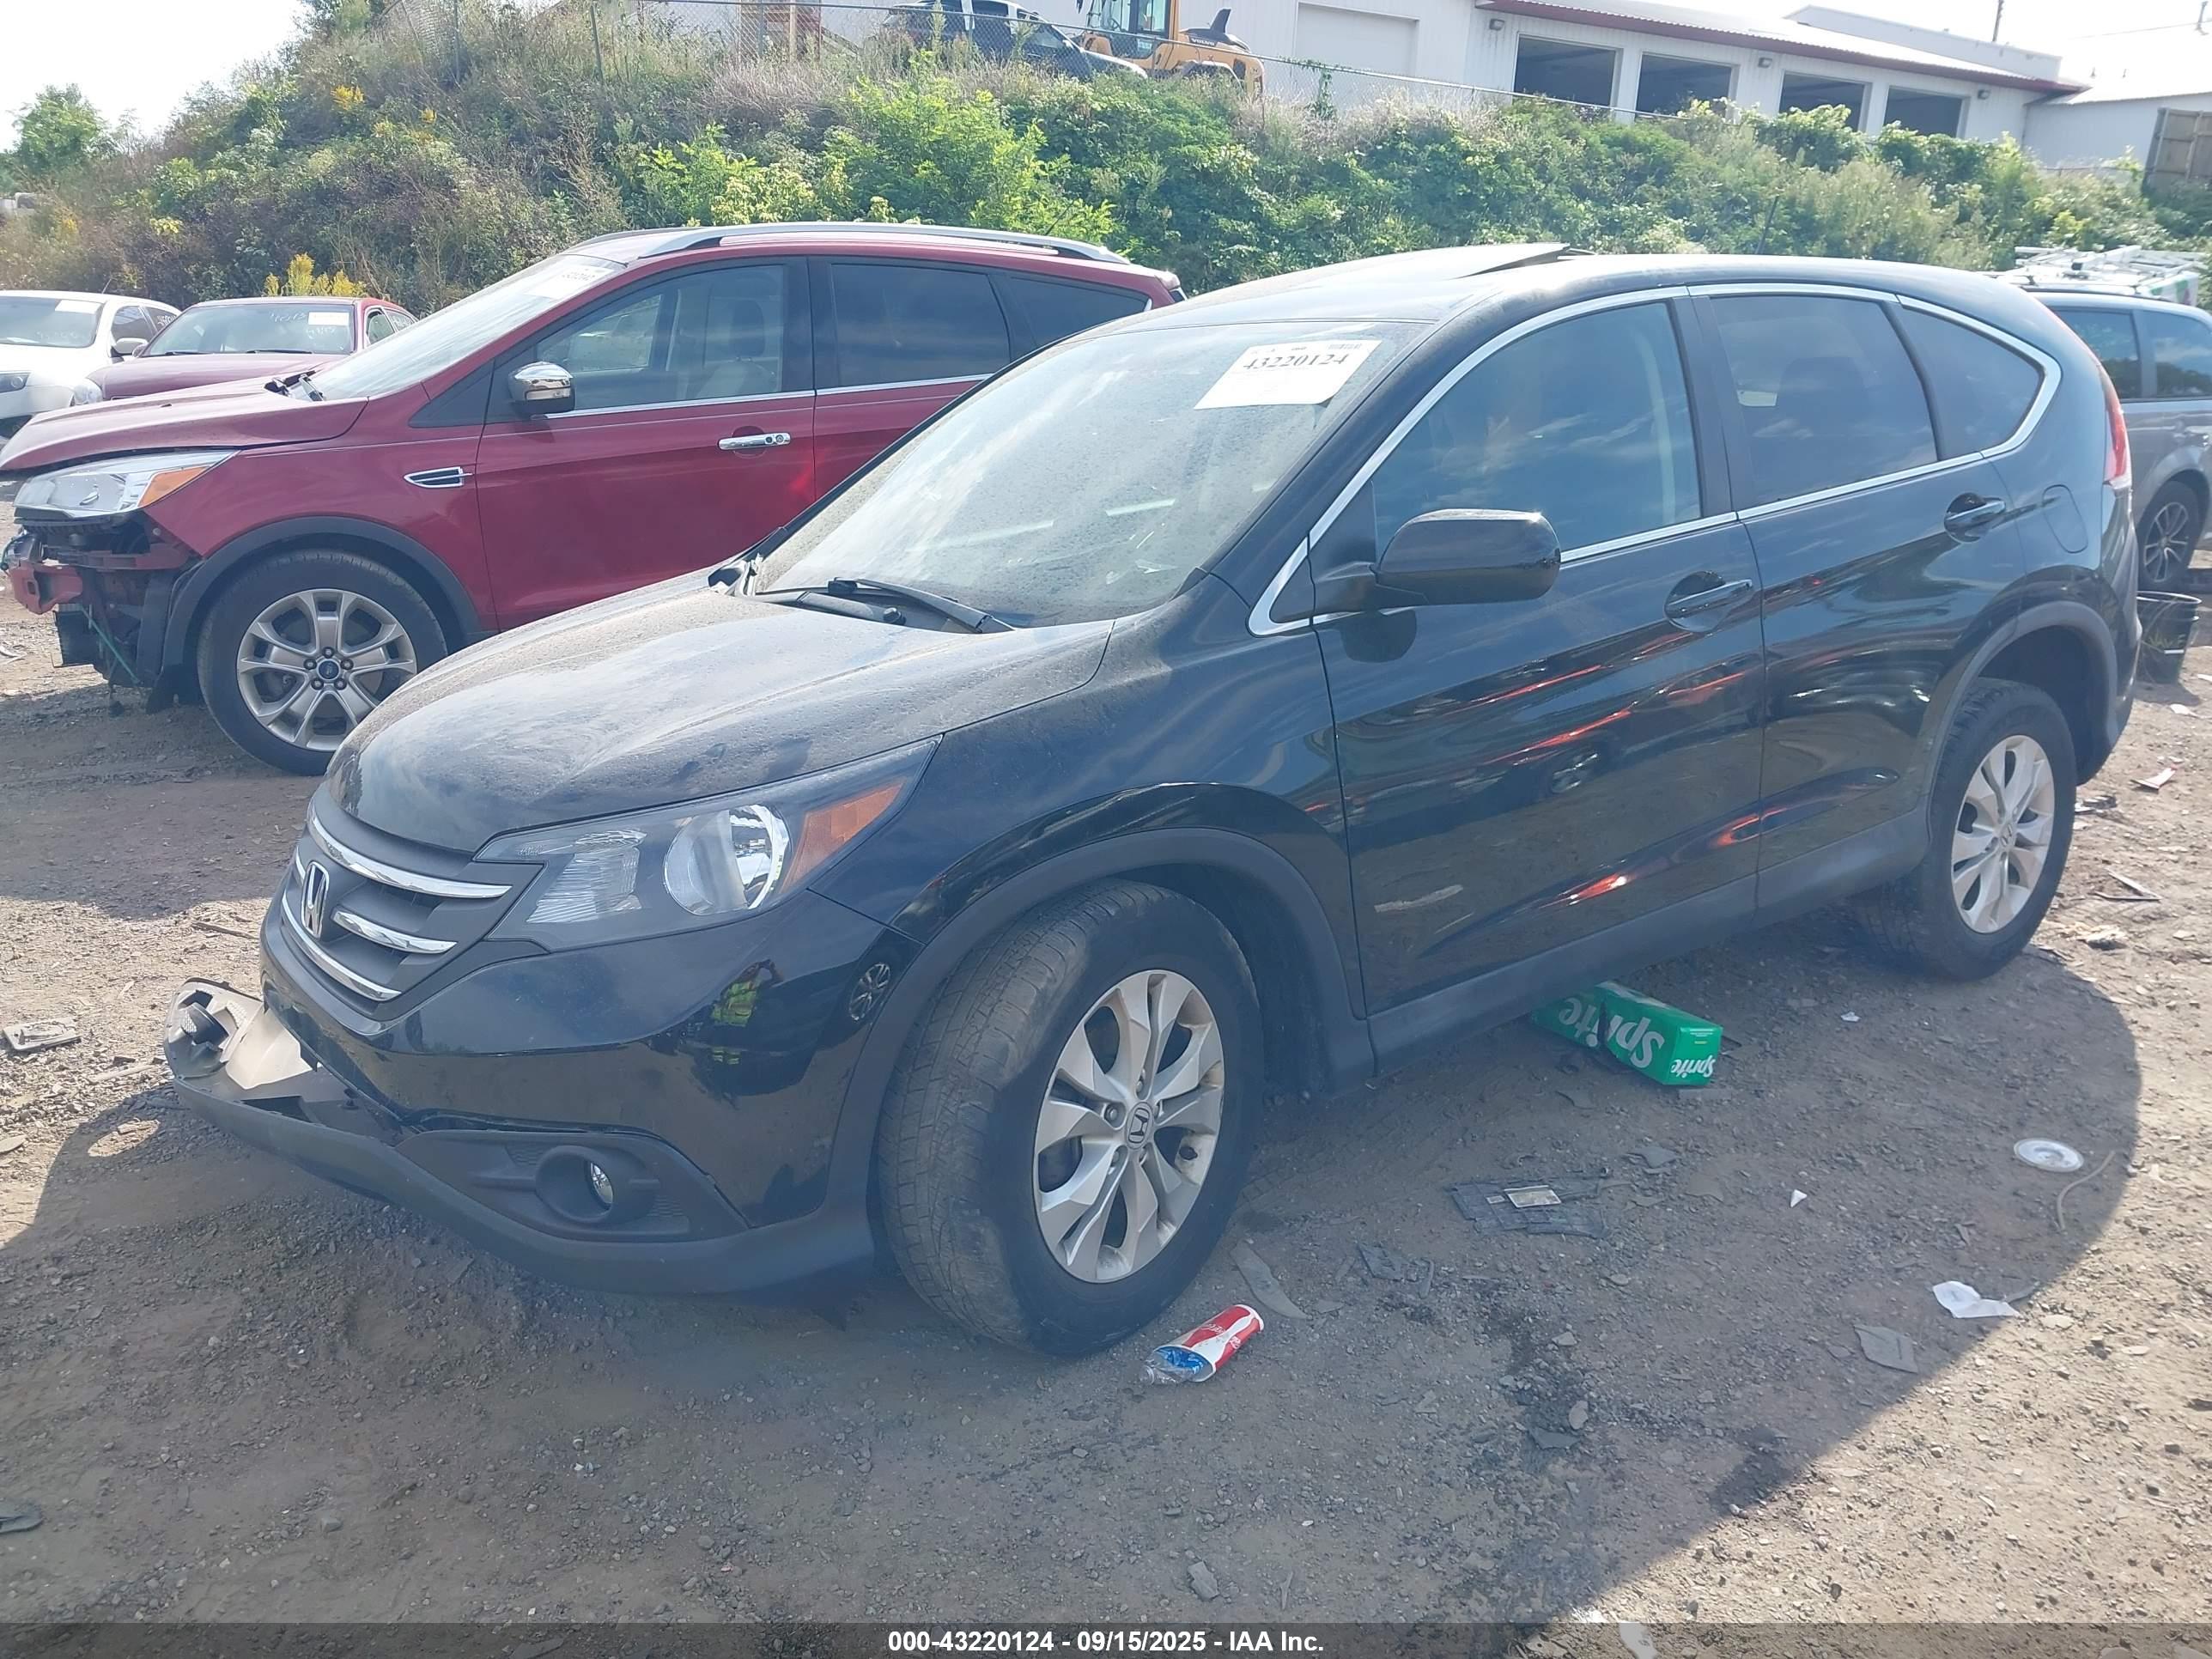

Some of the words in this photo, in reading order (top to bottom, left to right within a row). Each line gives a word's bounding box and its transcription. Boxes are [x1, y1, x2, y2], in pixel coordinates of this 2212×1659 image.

[1191, 38, 1215, 46] VOLVO
[1243, 353, 1350, 370] 43220124
[1670, 1054, 1717, 1079] Sprite
